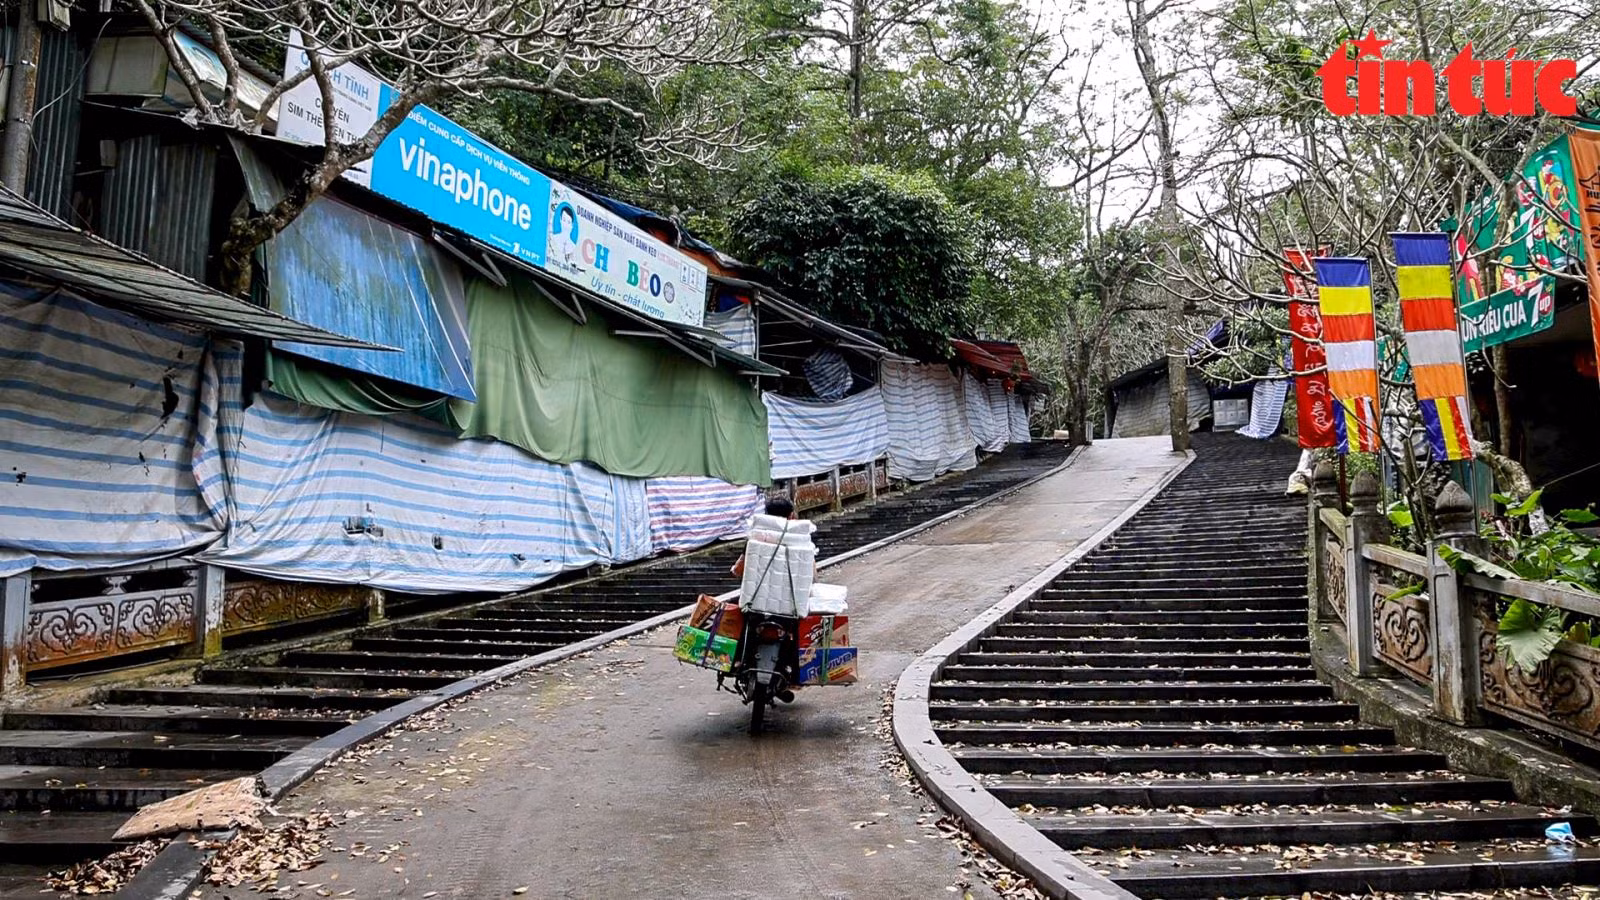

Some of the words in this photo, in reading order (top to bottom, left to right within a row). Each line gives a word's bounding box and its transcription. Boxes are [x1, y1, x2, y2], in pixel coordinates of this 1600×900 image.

[287, 101, 304, 118] SIM
[314, 97, 350, 123] CYÊN
[428, 121, 450, 139] CUNG
[399, 136, 533, 231] vinaphone
[626, 259, 662, 298] BÉO
[1503, 299, 1527, 329] CUA
